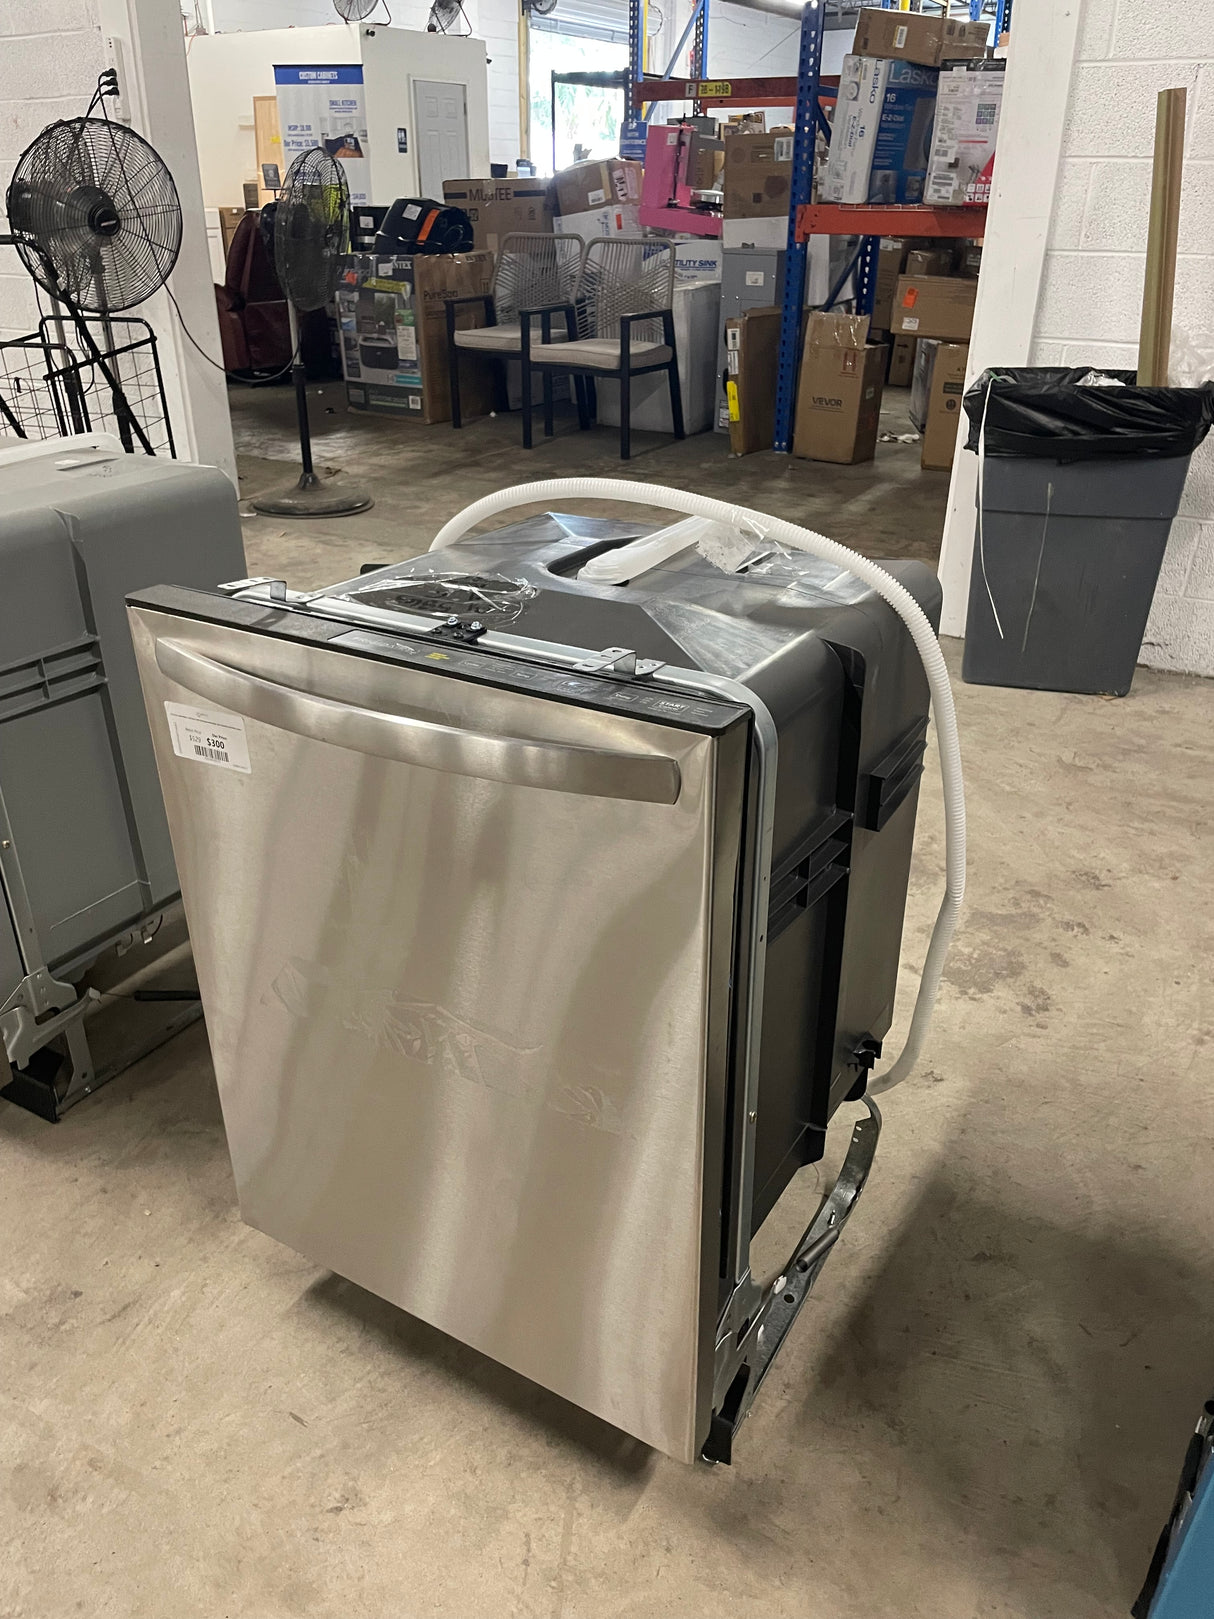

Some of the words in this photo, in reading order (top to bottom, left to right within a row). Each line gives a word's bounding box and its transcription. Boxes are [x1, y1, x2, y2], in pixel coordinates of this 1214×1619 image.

[889, 62, 937, 86] Lasko
[870, 59, 883, 104] Lasko
[886, 93, 896, 103] 16
[858, 125, 866, 138] 16
[392, 261, 412, 269] NTEX
[674, 259, 697, 267] TILITY
[698, 259, 718, 267] SINK
[812, 396, 843, 408] VEVOR
[206, 737, 224, 749] $300
